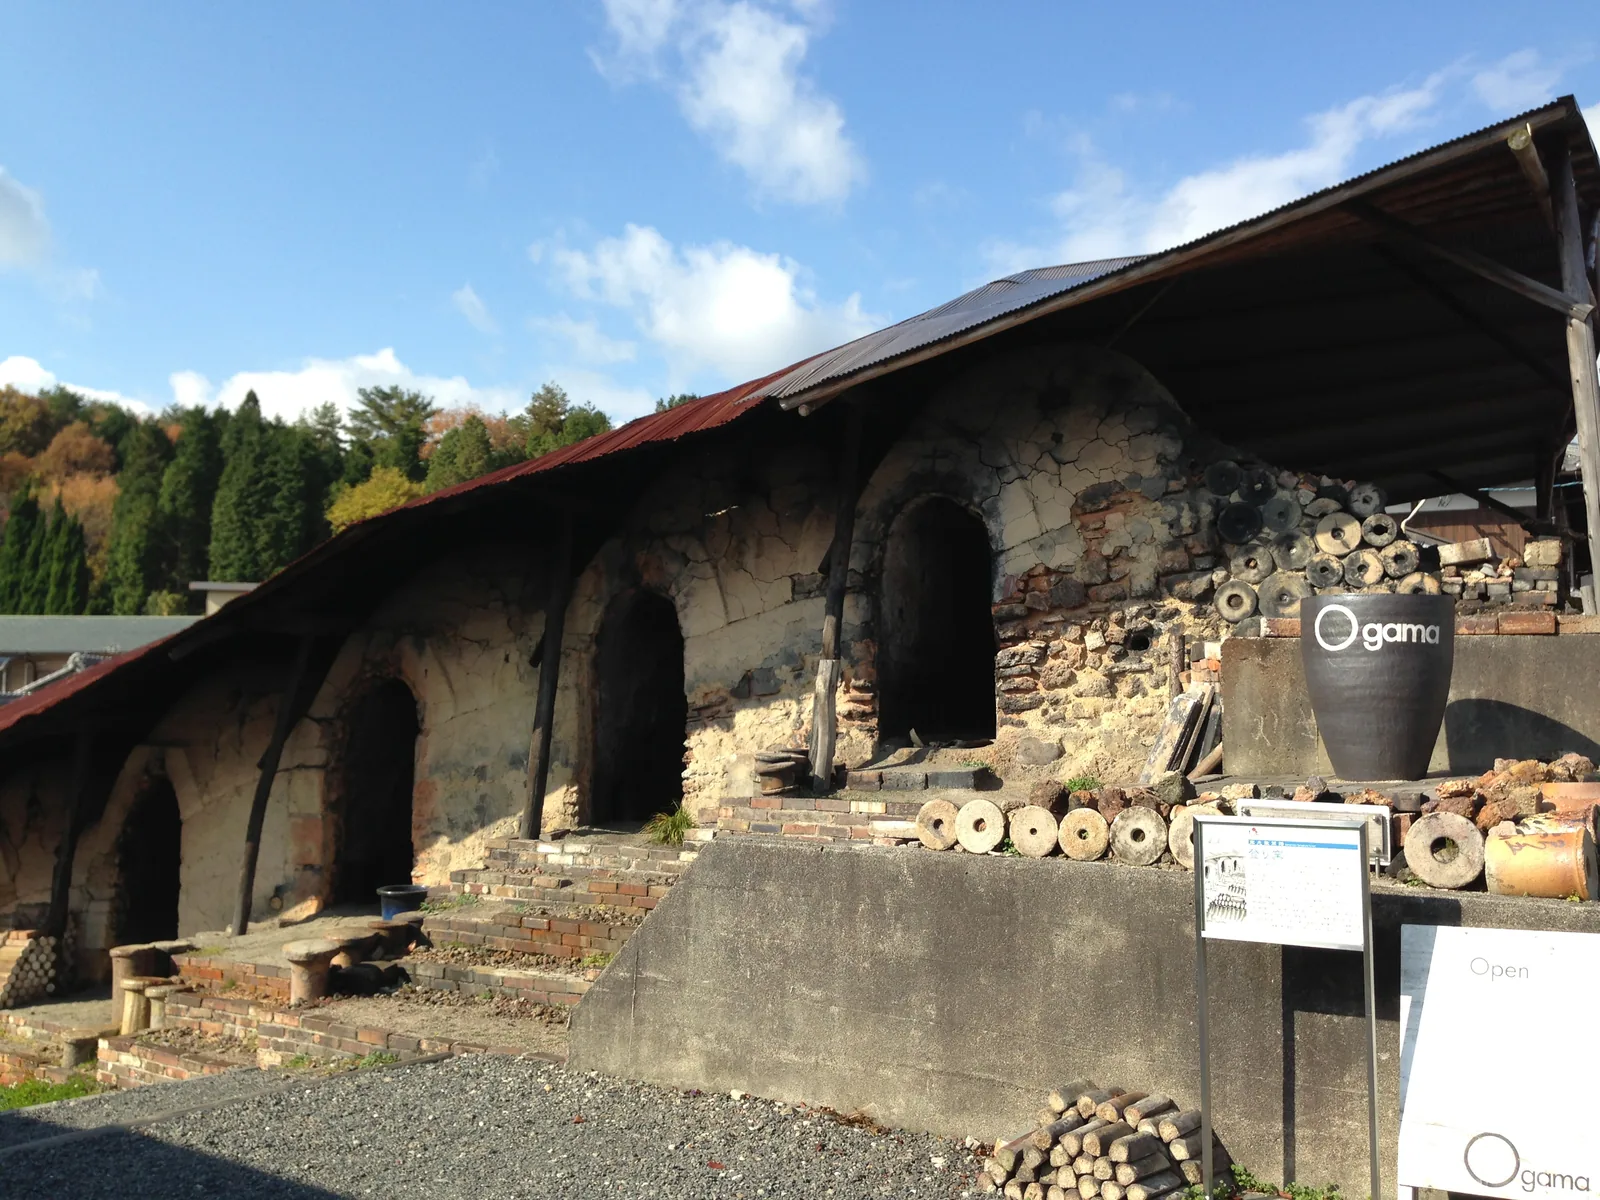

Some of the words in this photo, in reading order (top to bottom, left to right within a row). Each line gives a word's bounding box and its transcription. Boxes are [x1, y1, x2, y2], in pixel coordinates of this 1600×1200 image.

[1314, 604, 1440, 651] Ogama
[1470, 957, 1529, 982] Open
[1464, 1132, 1590, 1192] Ogama
